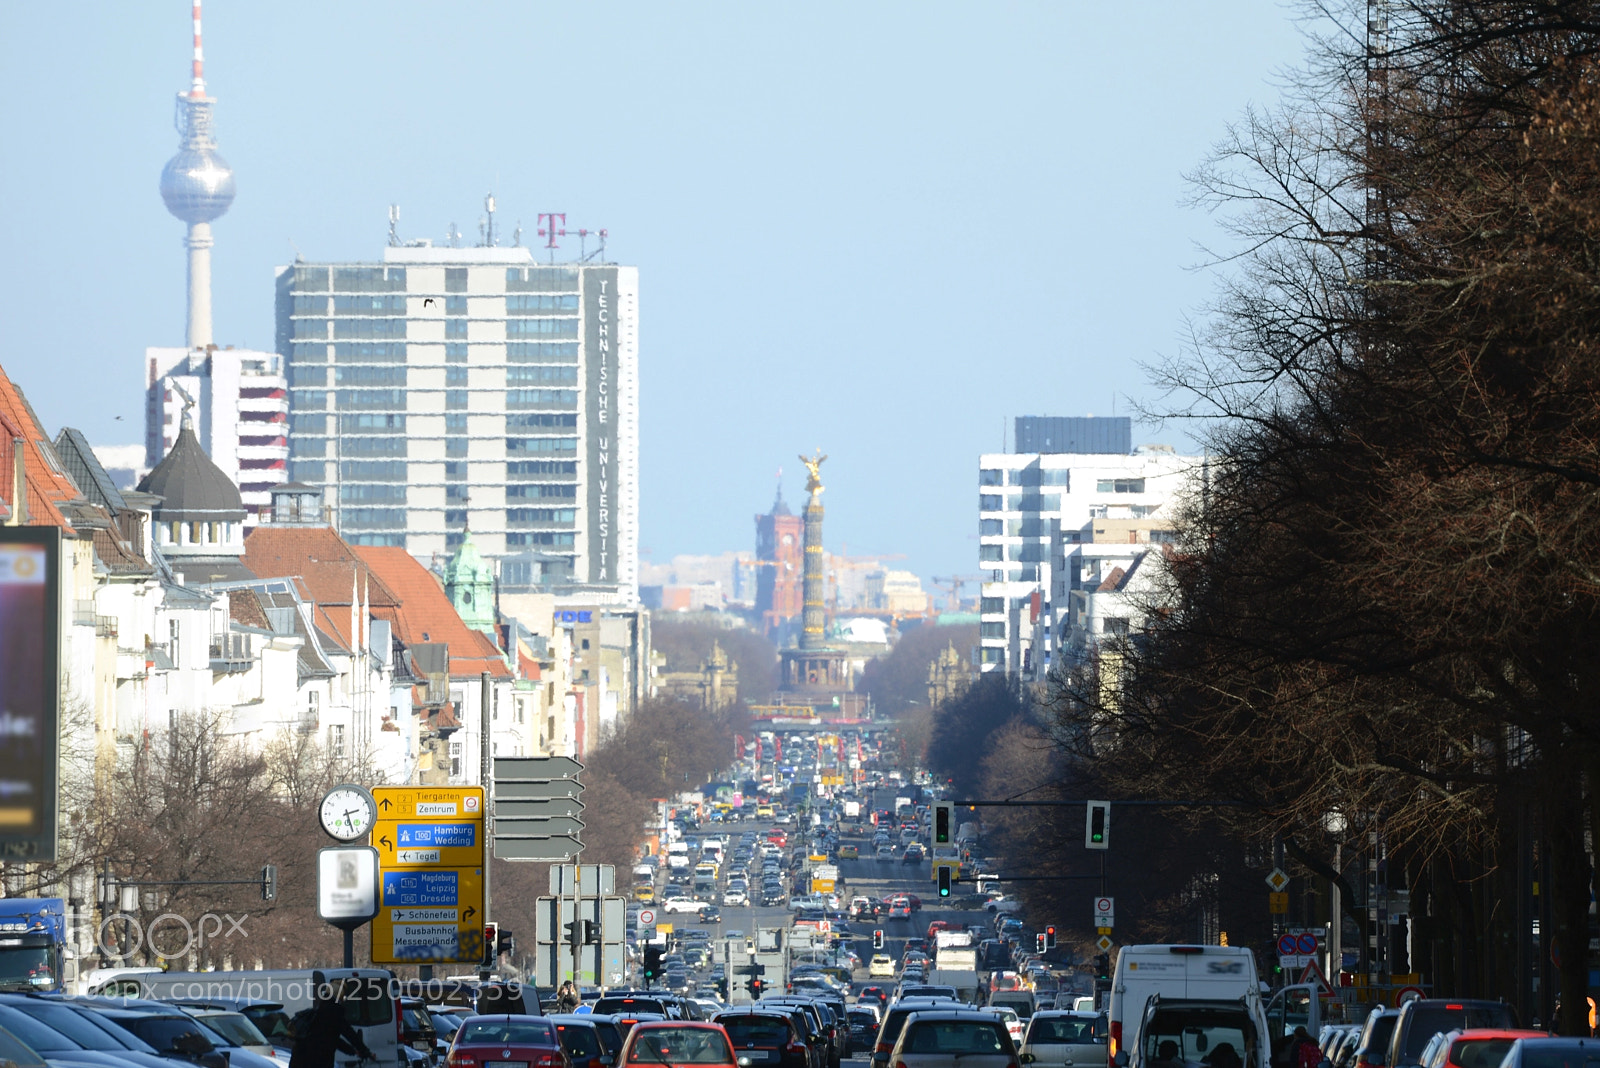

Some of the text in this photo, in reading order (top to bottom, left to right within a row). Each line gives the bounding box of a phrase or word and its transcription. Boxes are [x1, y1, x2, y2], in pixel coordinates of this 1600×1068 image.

[598, 280, 609, 423] TECHNISCHE
[416, 792, 460, 801] Tiergarten
[419, 804, 455, 813] Zentrum
[434, 826, 473, 835] Hamburg
[434, 836, 471, 846] Wedding
[415, 852, 438, 861] Tegel
[421, 873, 456, 883] Magdeburg
[426, 884, 456, 893] Leipzig
[420, 894, 456, 902] Dresden
[408, 911, 456, 919] Schönefeld
[405, 926, 456, 935] Busbahnhof
[395, 937, 456, 946] Messegelände
